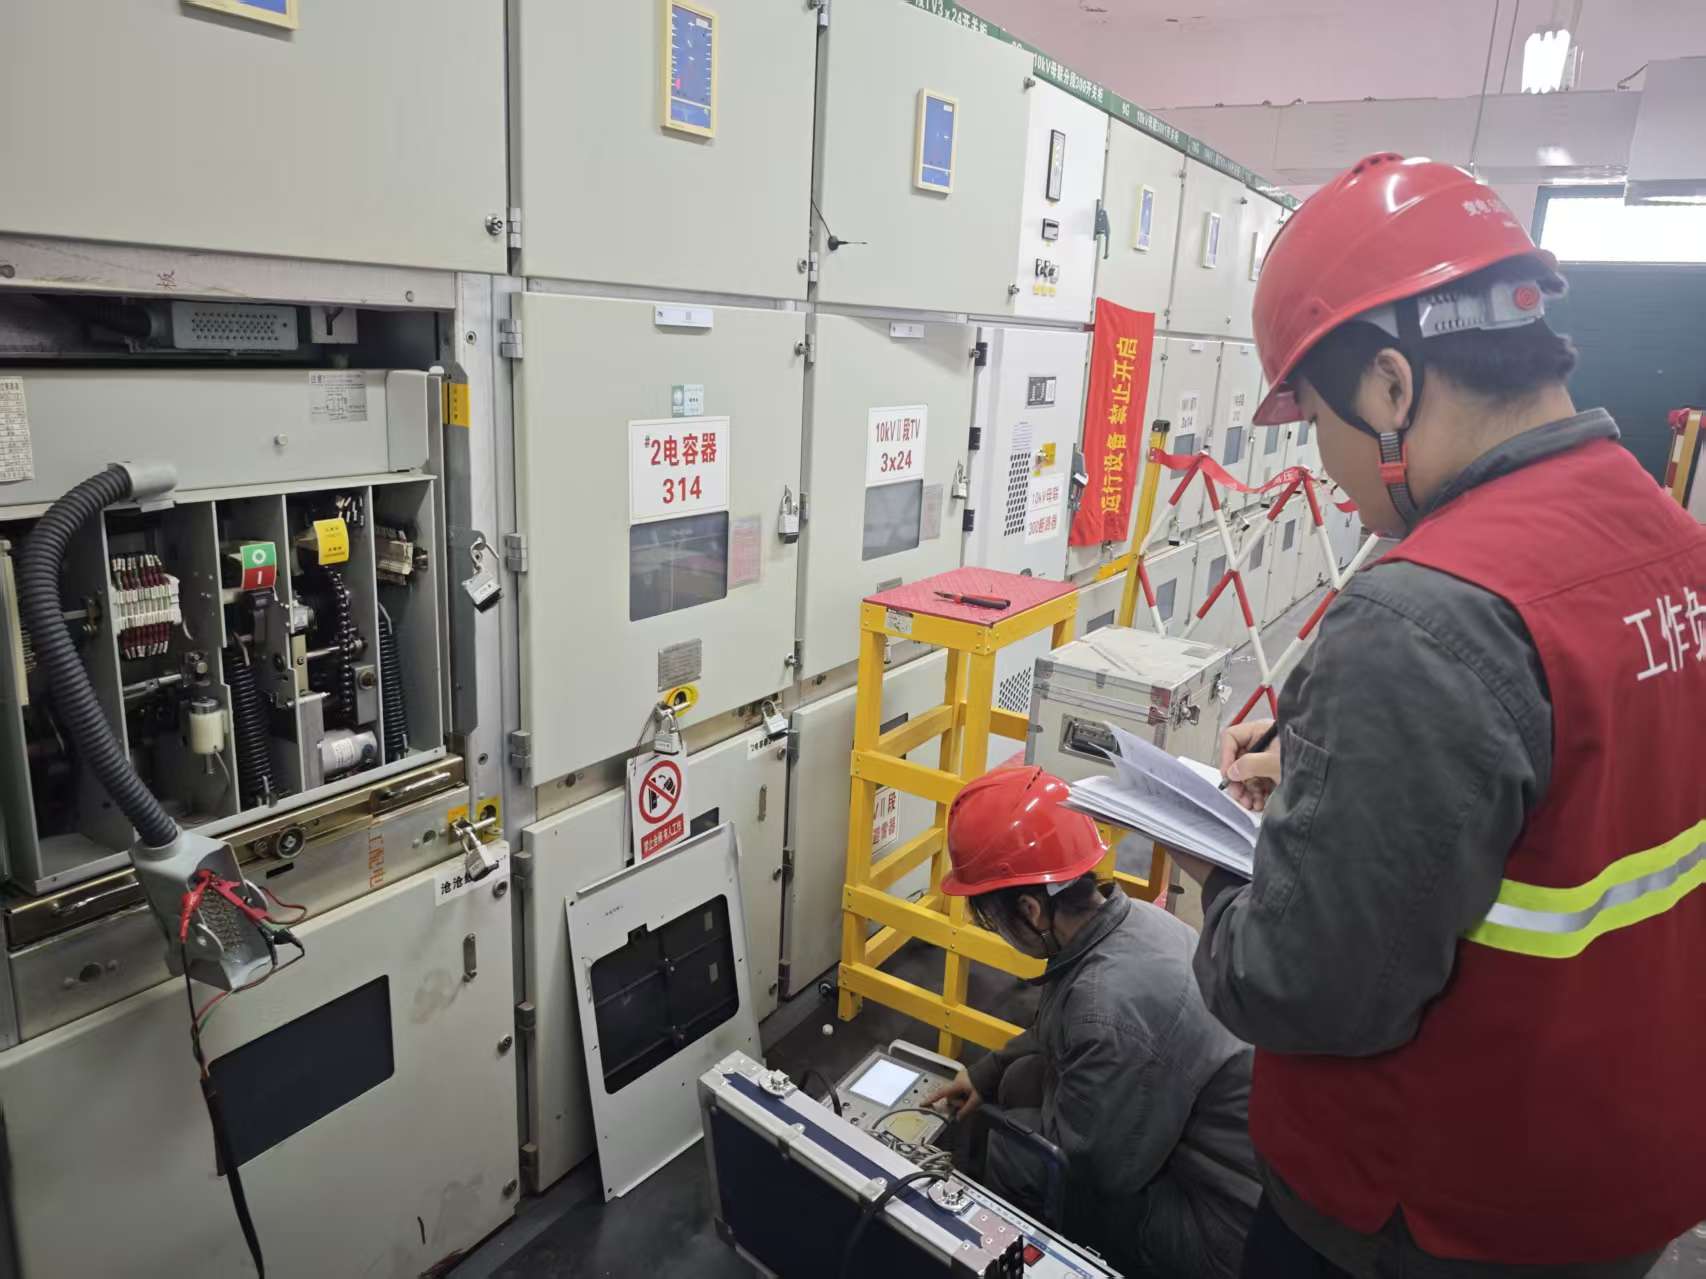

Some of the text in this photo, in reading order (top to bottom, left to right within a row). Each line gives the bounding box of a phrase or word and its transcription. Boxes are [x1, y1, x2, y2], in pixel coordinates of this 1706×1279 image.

[1101, 336, 1139, 514] 运行设备 禁止开启
[662, 476, 702, 504] 314
